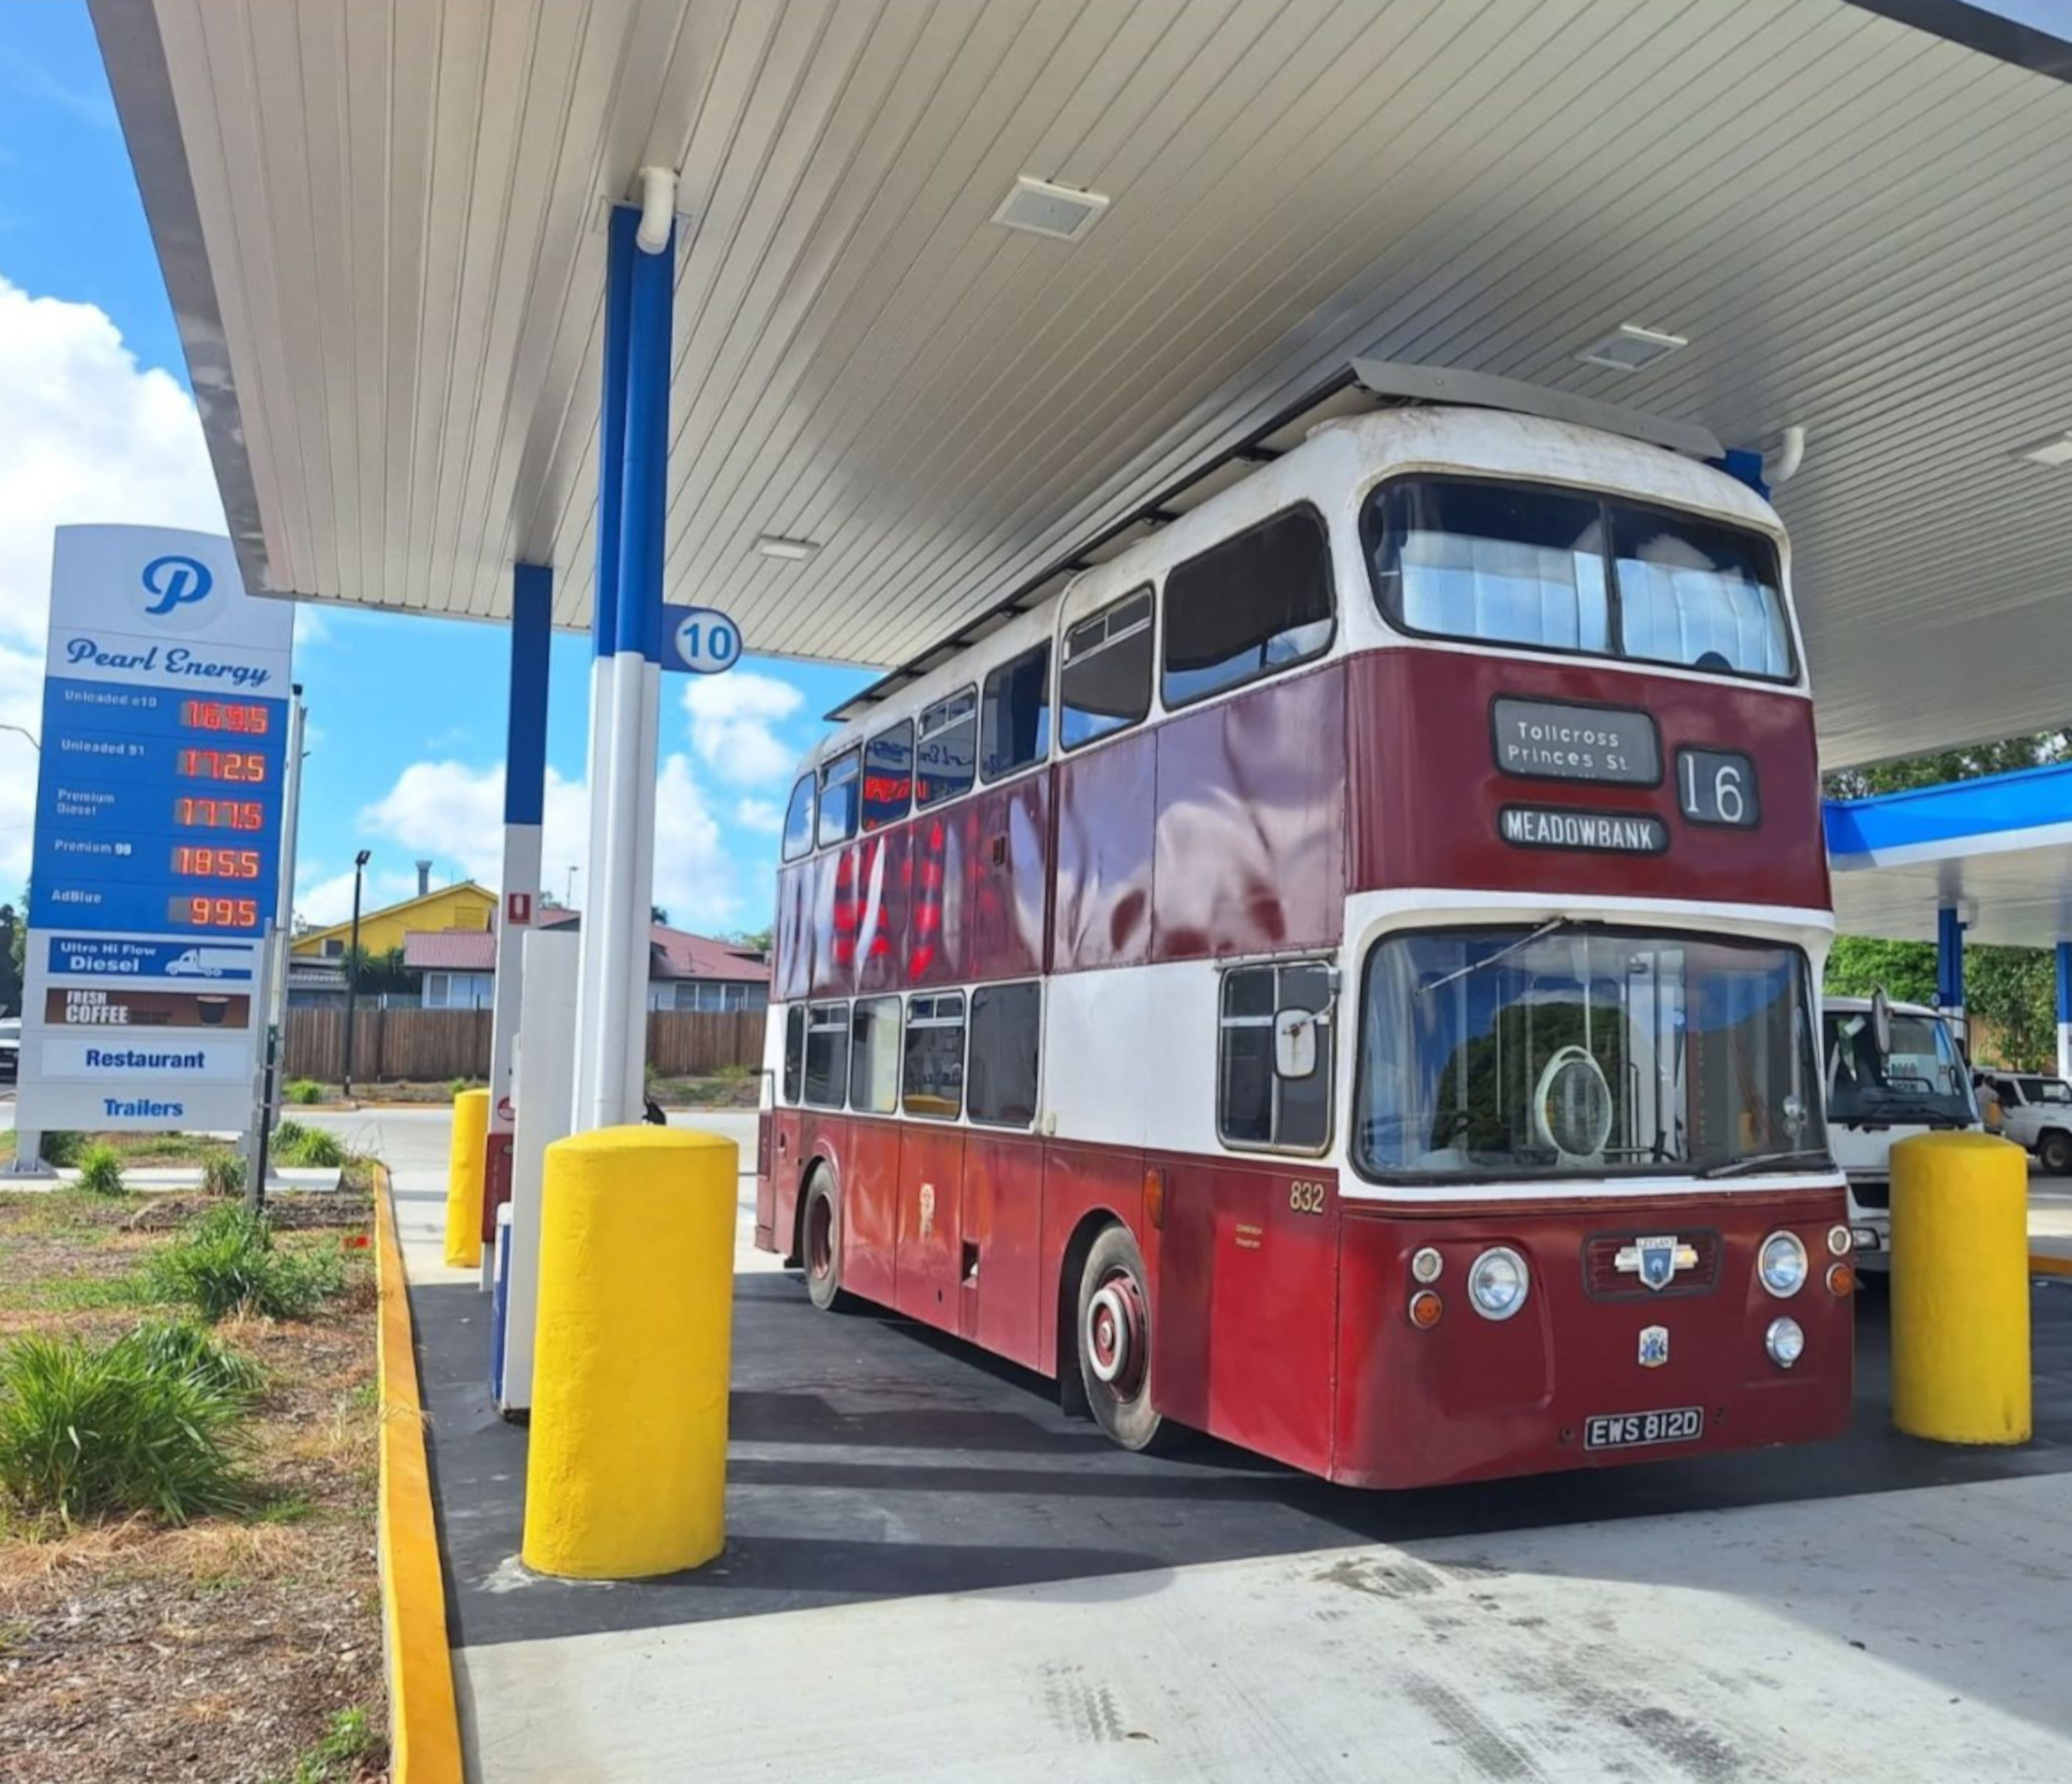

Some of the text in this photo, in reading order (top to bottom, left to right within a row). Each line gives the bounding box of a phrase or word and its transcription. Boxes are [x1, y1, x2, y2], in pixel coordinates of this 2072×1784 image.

[683, 623, 732, 661] 10
[66, 638, 271, 686] Pearl Energy
[65, 689, 128, 705] Unleaded
[1518, 721, 1619, 748] Tollcross
[61, 739, 144, 755] Unleaded 91
[1508, 745, 1593, 767] Princes
[185, 749, 264, 781] 172.5
[58, 788, 114, 803] Premium
[1686, 754, 1744, 822] 16
[57, 802, 96, 816] Diesel
[1507, 810, 1653, 850] MEADOWBANK
[55, 839, 132, 856] Premium 98
[180, 847, 259, 878] 185.5
[51, 889, 101, 904] AdBlue
[192, 897, 256, 927] 99.5
[61, 942, 156, 956] Ultra Hi Flow
[70, 957, 139, 972] Diesel
[67, 991, 107, 1004] FRESH
[65, 1006, 128, 1024] COFFEE
[86, 1050, 205, 1068] Restaurant
[104, 1098, 183, 1116] Trailers
[1290, 1181, 1324, 1213] 832
[1591, 1411, 1699, 1444] EWS 812D
